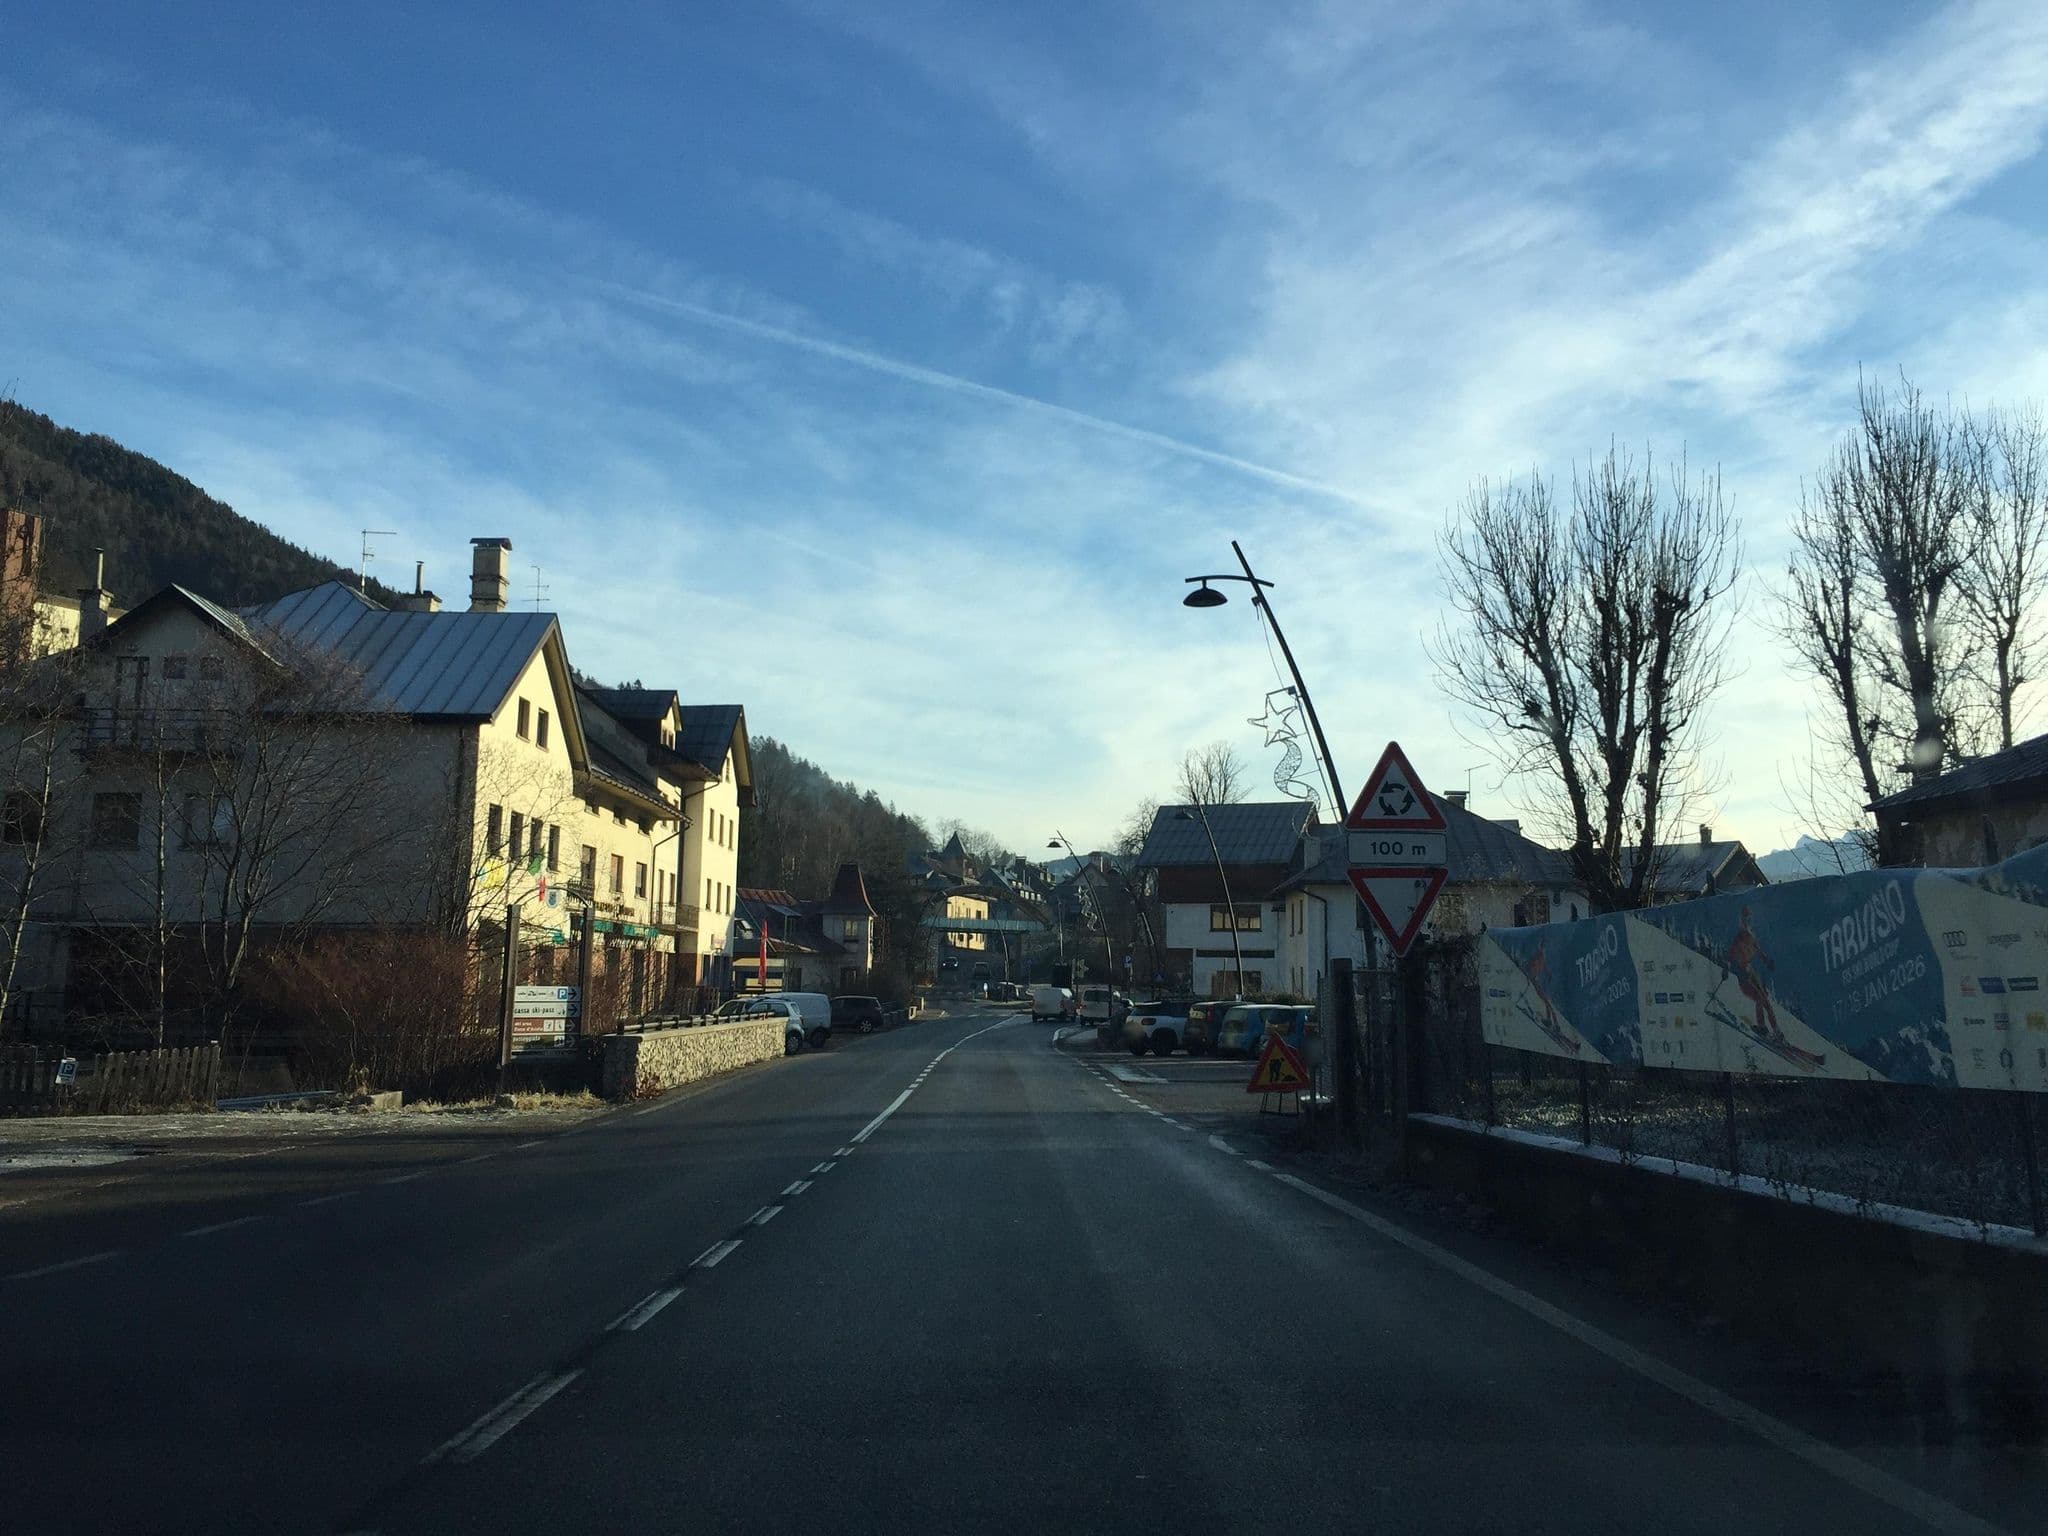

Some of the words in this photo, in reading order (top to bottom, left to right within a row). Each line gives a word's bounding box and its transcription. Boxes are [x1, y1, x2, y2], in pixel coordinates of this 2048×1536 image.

[1370, 841, 1404, 856] 100
[1411, 845, 1426, 856] m
[1818, 879, 1904, 973] TARVISIO
[1864, 976, 1888, 1008] JAN
[1889, 953, 1926, 992] 2026
